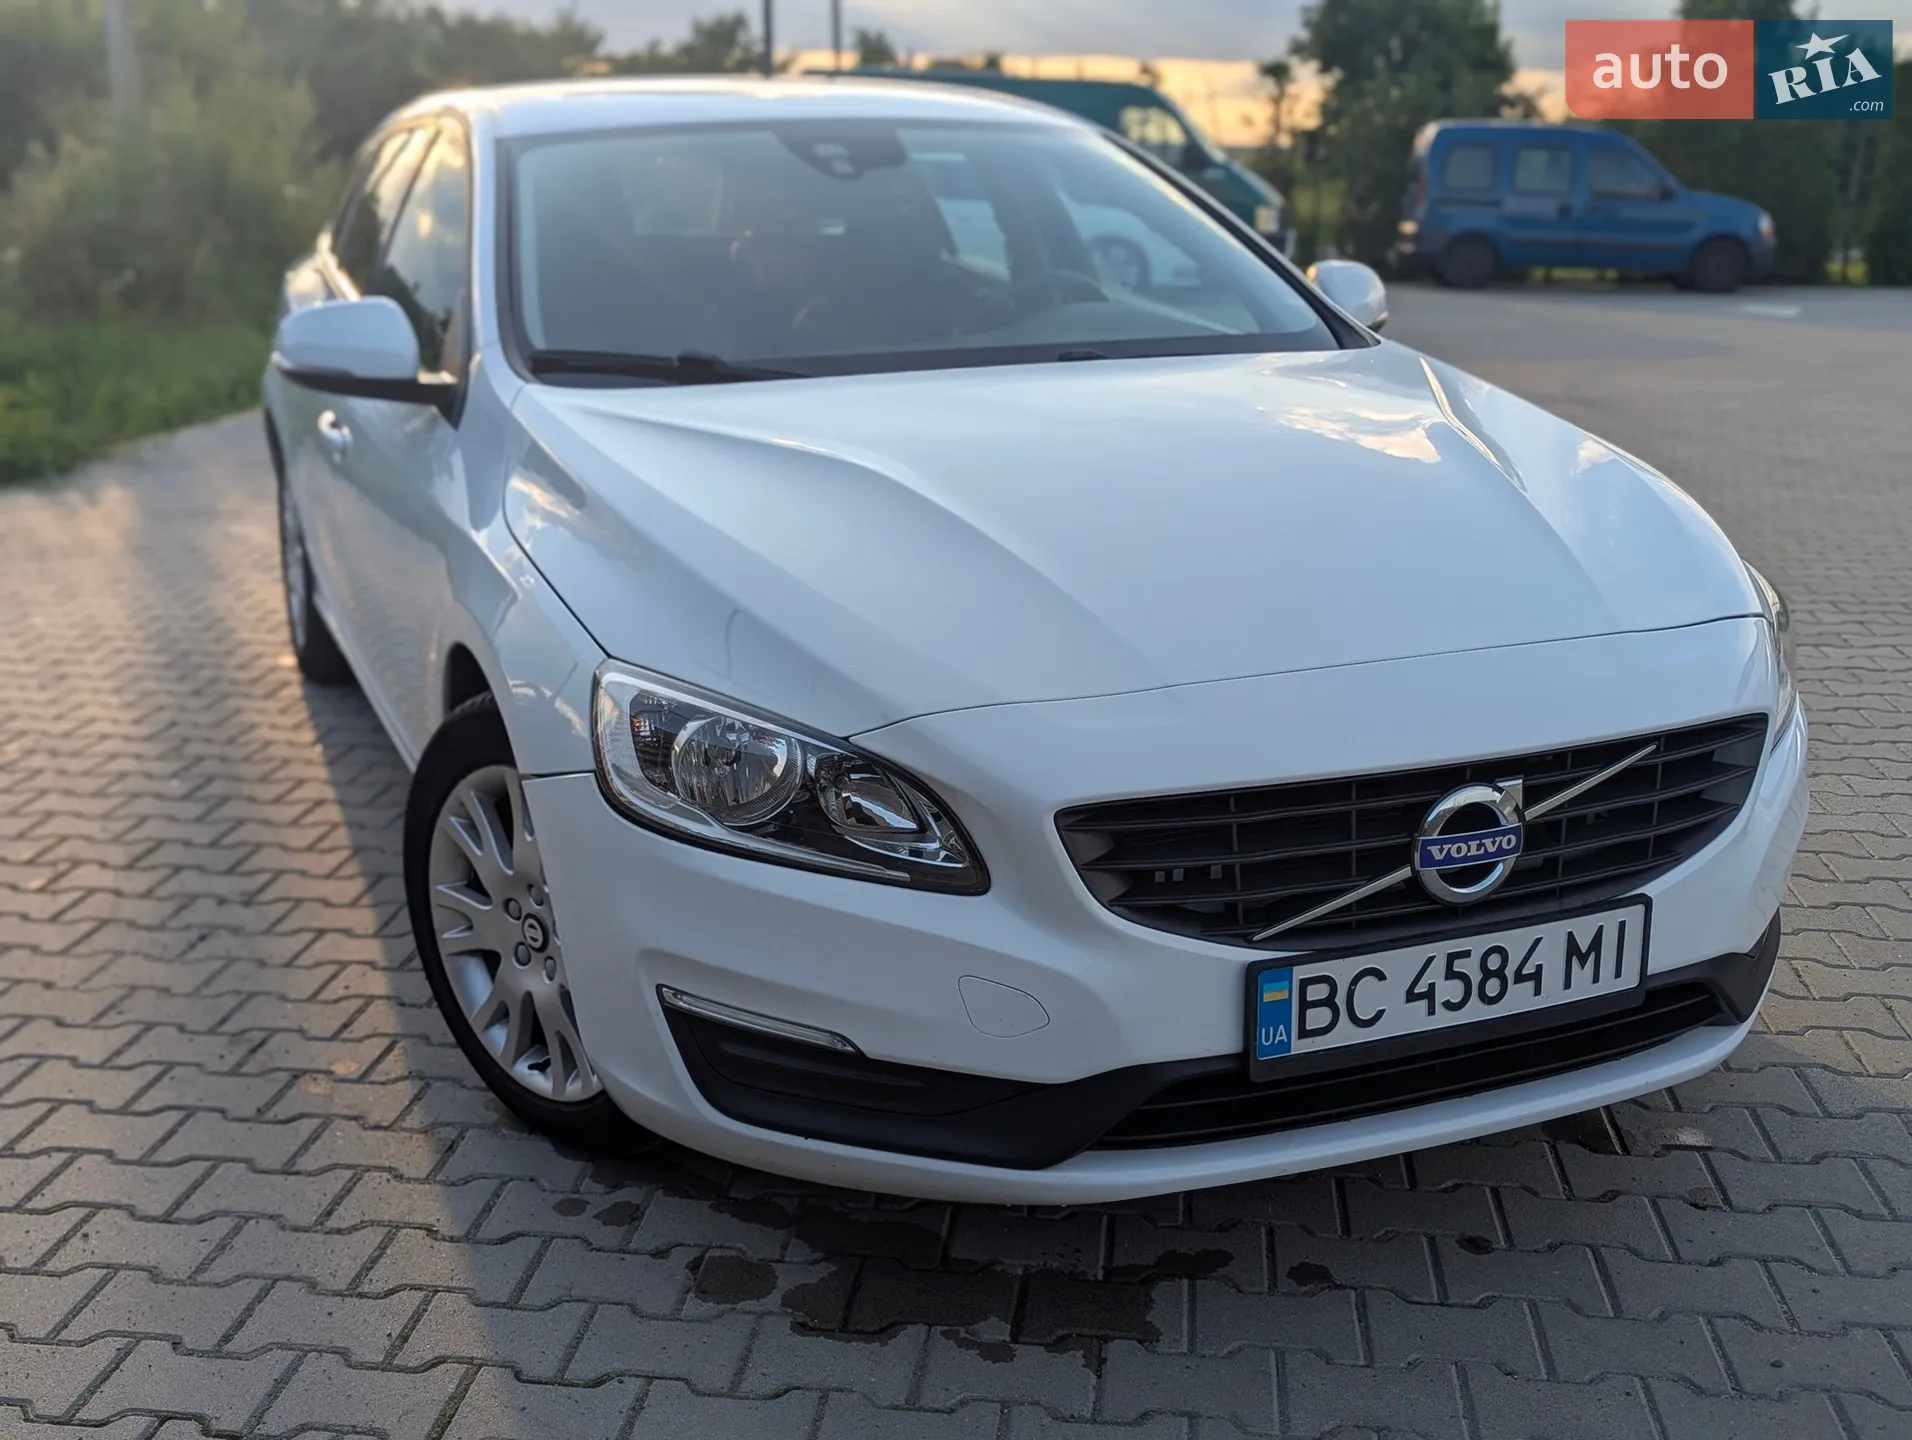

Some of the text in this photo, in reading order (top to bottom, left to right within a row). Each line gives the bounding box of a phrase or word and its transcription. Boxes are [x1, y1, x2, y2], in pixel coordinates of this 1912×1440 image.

[1427, 834, 1517, 860] VOLVO
[1297, 919, 1627, 1040] BC 4584 MI
[1261, 1027, 1288, 1046] UA
